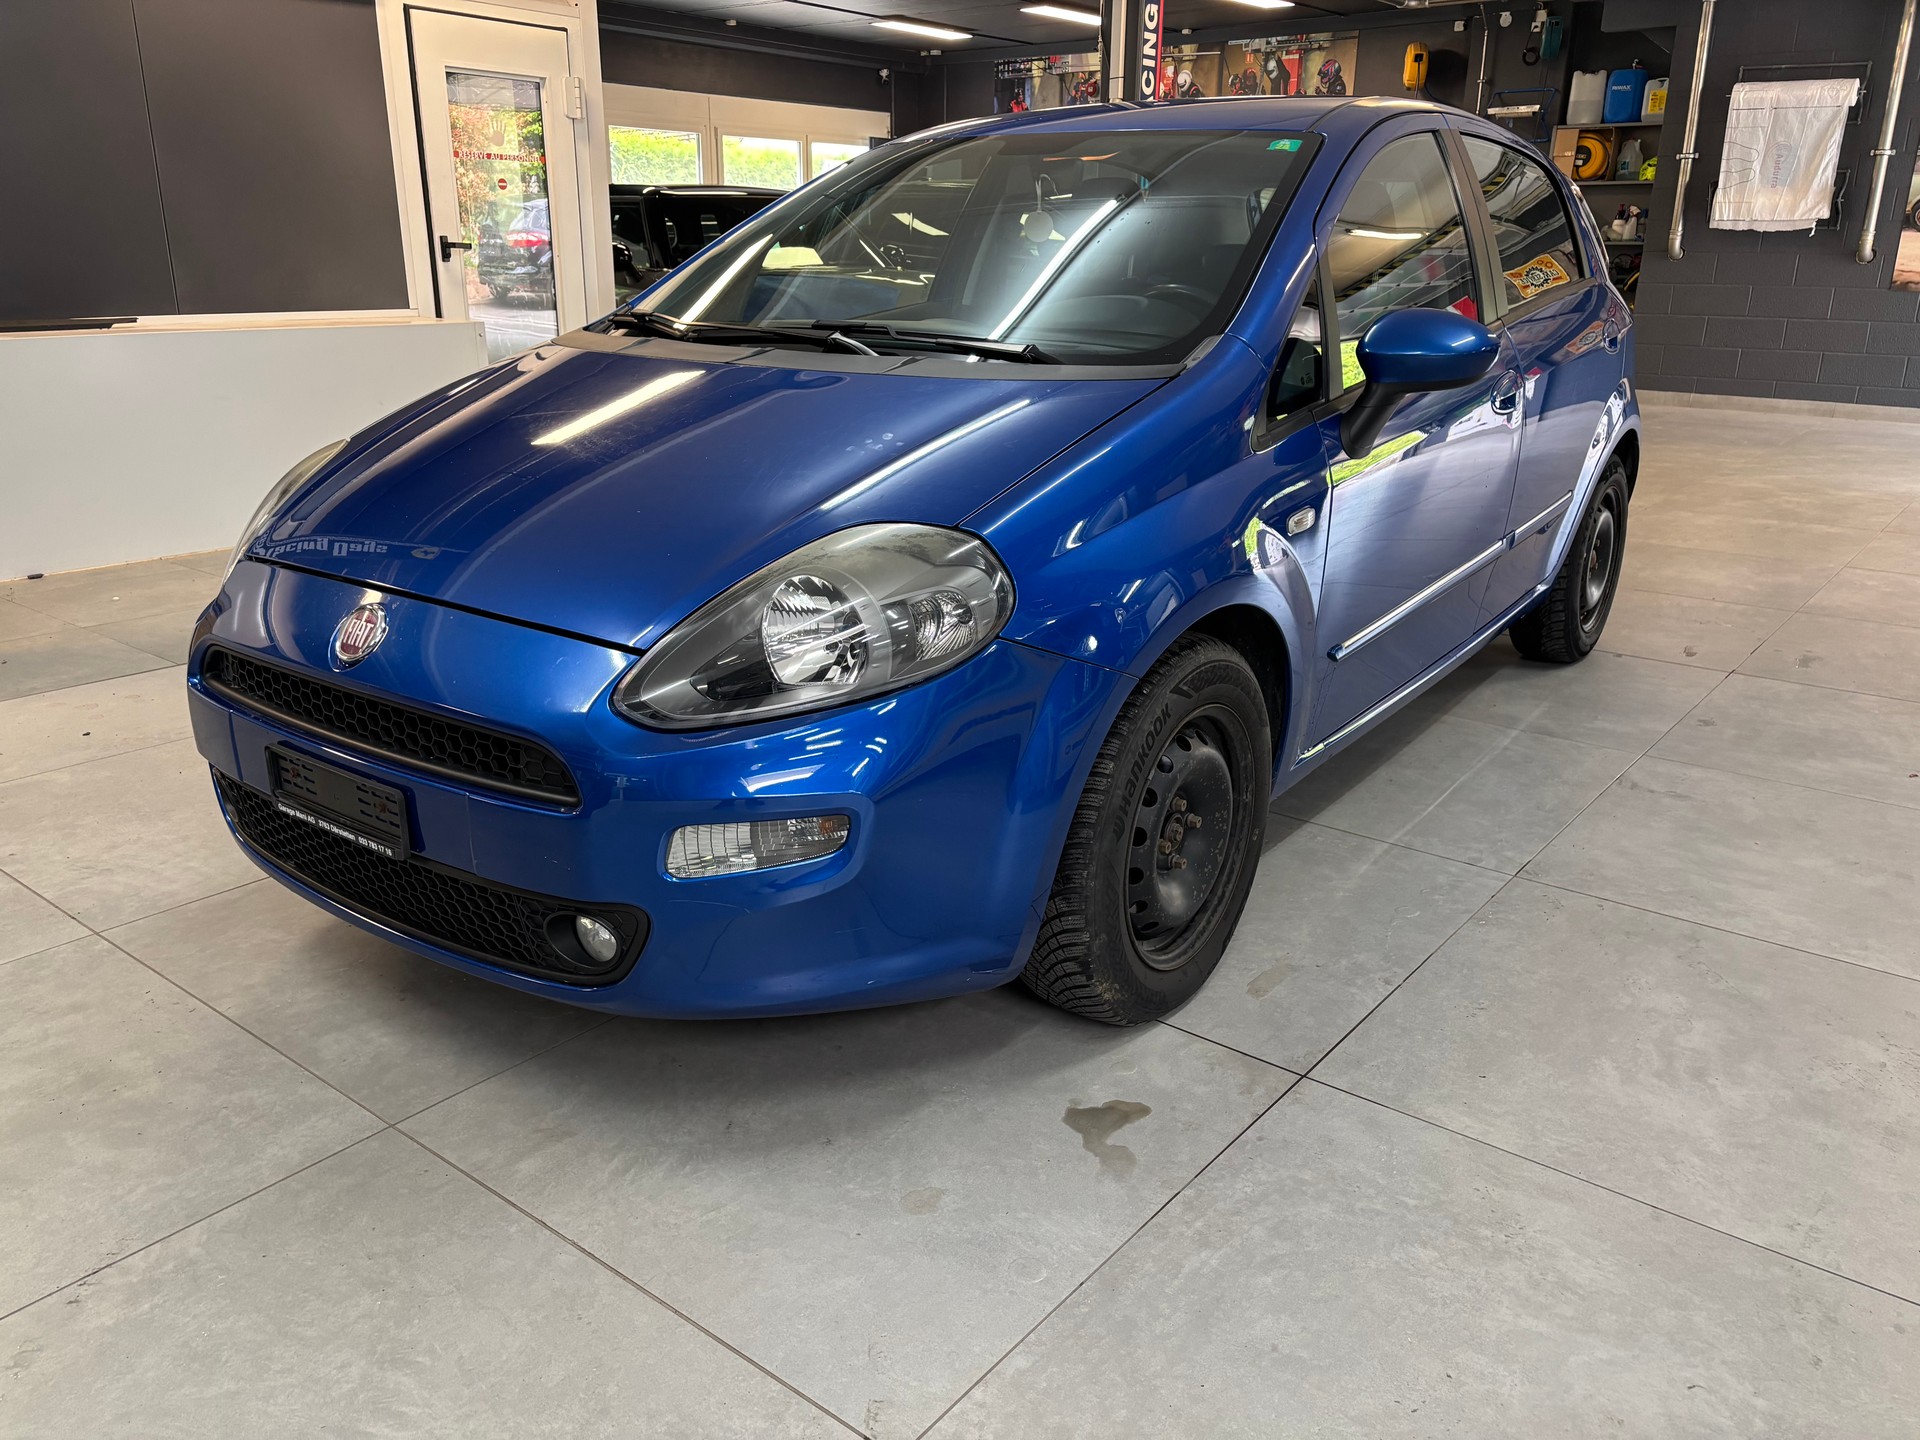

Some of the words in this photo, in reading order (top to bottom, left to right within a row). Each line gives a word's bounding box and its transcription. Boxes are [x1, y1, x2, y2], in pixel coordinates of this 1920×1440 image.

[1141, 3, 1159, 101] CING
[490, 153, 501, 161] AU
[503, 153, 541, 163] PERSONNEL
[343, 619, 375, 648] FIAT
[278, 803, 296, 816] Garage
